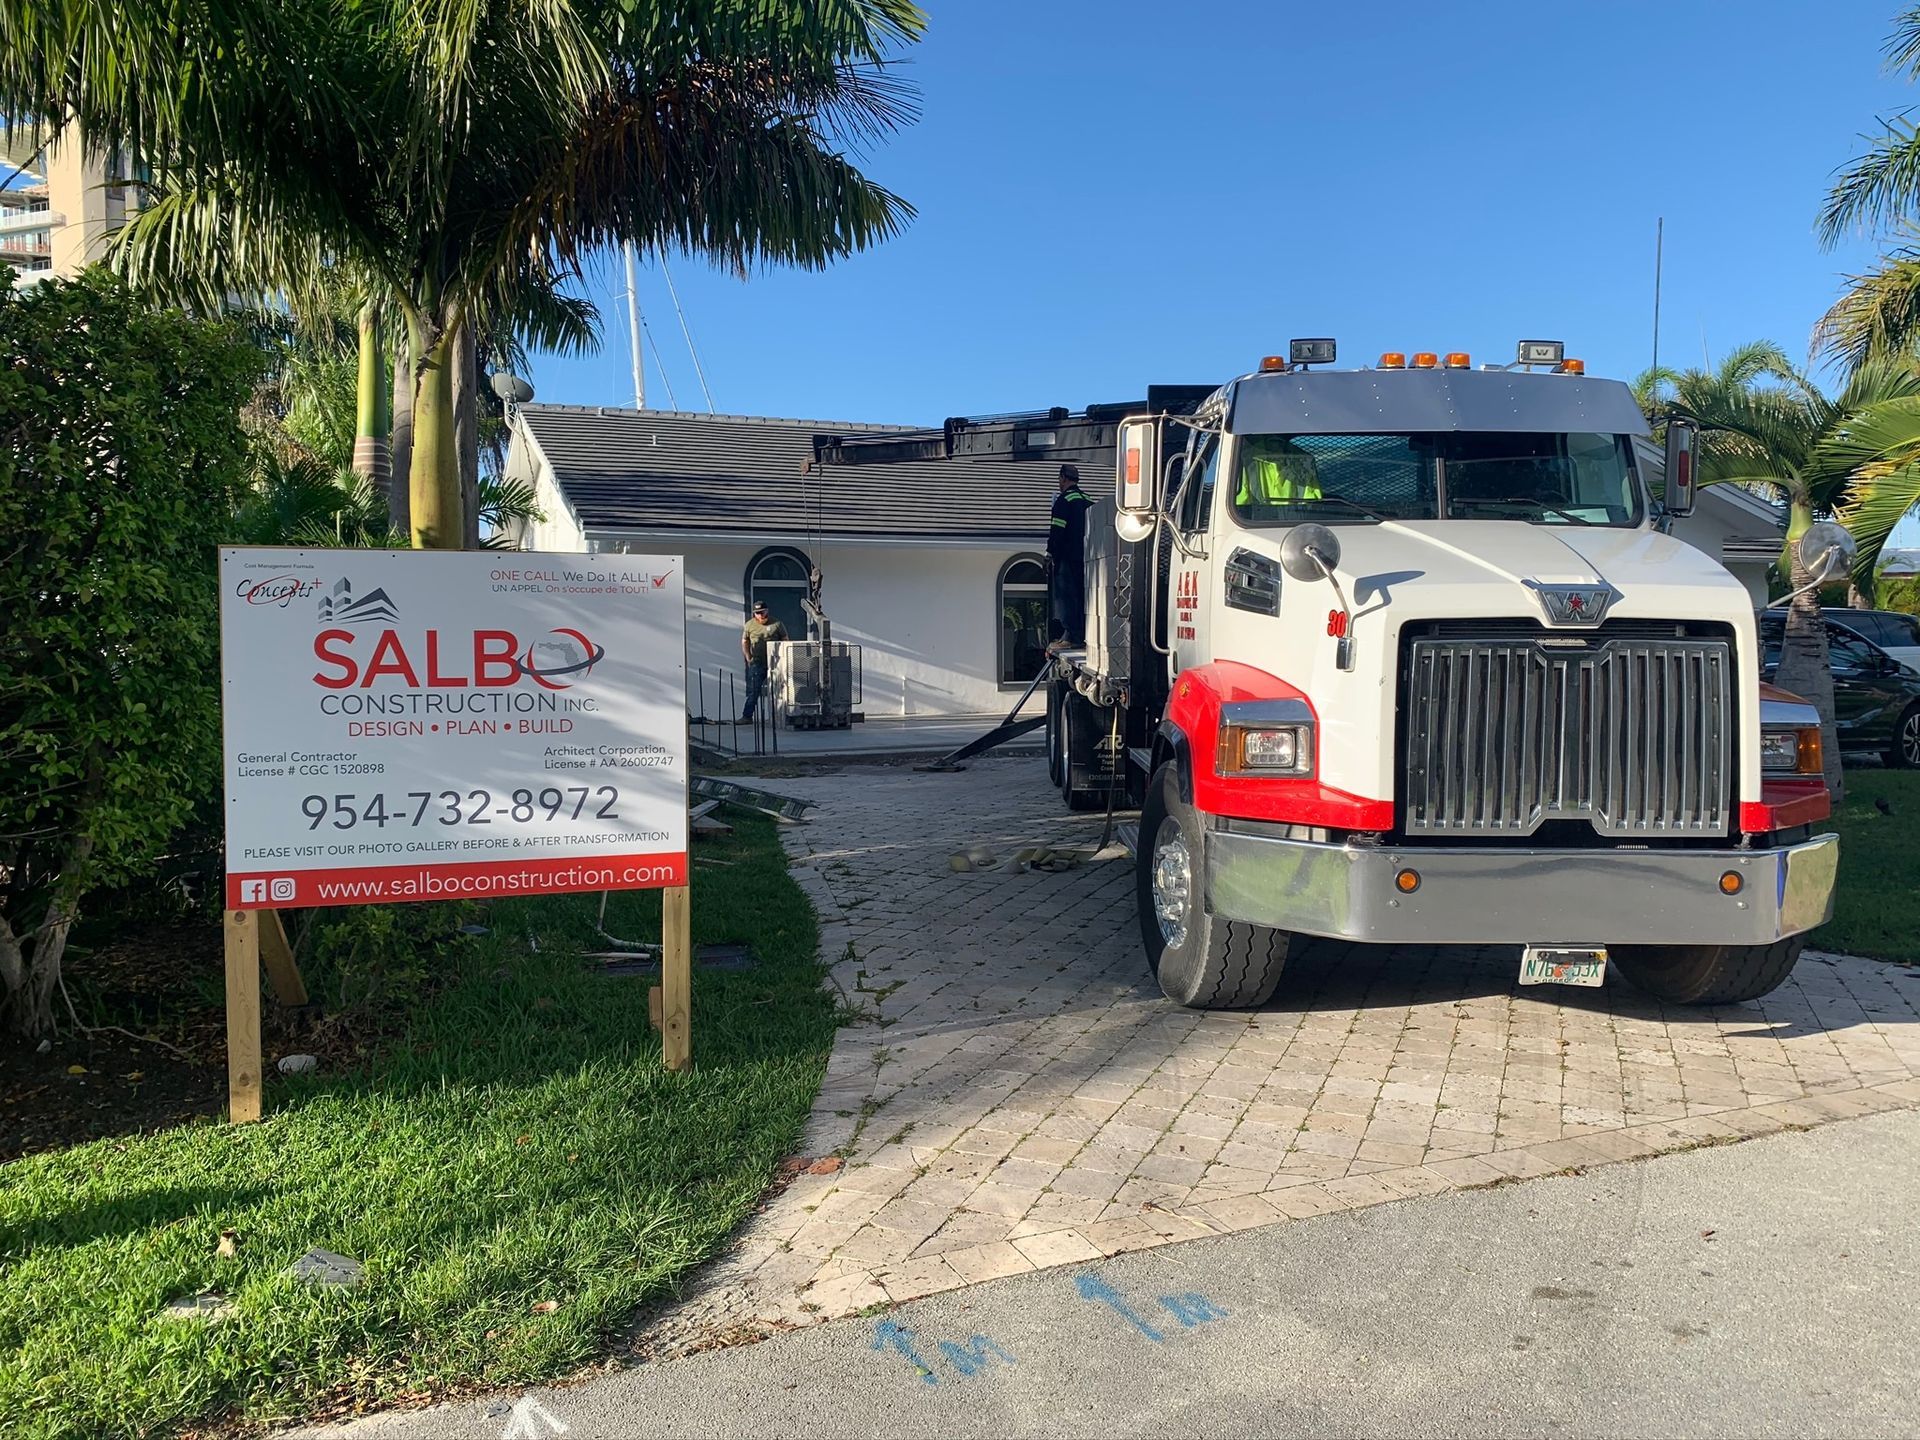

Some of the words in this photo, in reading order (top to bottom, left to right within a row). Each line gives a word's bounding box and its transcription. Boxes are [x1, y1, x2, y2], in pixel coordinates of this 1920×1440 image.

[490, 570, 520, 582] ONE
[523, 570, 559, 582] CALL
[562, 571, 584, 583] We
[587, 572, 605, 583] Do
[608, 572, 617, 583] It
[620, 573, 649, 583] ALL!
[491, 584, 508, 593] UN
[510, 584, 543, 593] APPEL
[545, 585, 560, 593] On
[562, 585, 603, 595] s'occupe
[605, 586, 618, 594] de
[620, 586, 649, 594] TOUT!
[1326, 608, 1347, 639] 30
[312, 628, 605, 690] SALBO
[320, 693, 556, 716] CONSTRUCTION
[563, 698, 600, 713] INC.
[348, 720, 424, 738] DESIGN
[446, 720, 497, 736] PLAN
[518, 718, 574, 735] BUILD
[237, 752, 287, 764] General
[290, 751, 358, 763] Contractor
[544, 746, 596, 757] Architect
[598, 744, 667, 758] Corporation
[238, 766, 285, 777] License
[288, 766, 295, 776] #
[299, 764, 329, 776] CGC
[333, 763, 386, 775] 1520898
[544, 759, 587, 770] License
[589, 758, 597, 768] #
[599, 758, 618, 768] AA
[620, 756, 674, 768] 26002747
[301, 785, 620, 831] 954-732-8972
[244, 847, 292, 859] PLEASE
[294, 846, 325, 857] VISIT
[327, 844, 355, 856] OUR
[358, 843, 403, 854] PHOTO
[405, 840, 460, 852] GALLERY
[463, 838, 509, 850] BEFORE
[512, 837, 521, 848] &
[524, 836, 562, 847] AFTER
[564, 831, 670, 845] TRANSFORMATION
[318, 865, 674, 899] www.salboconstruction.com
